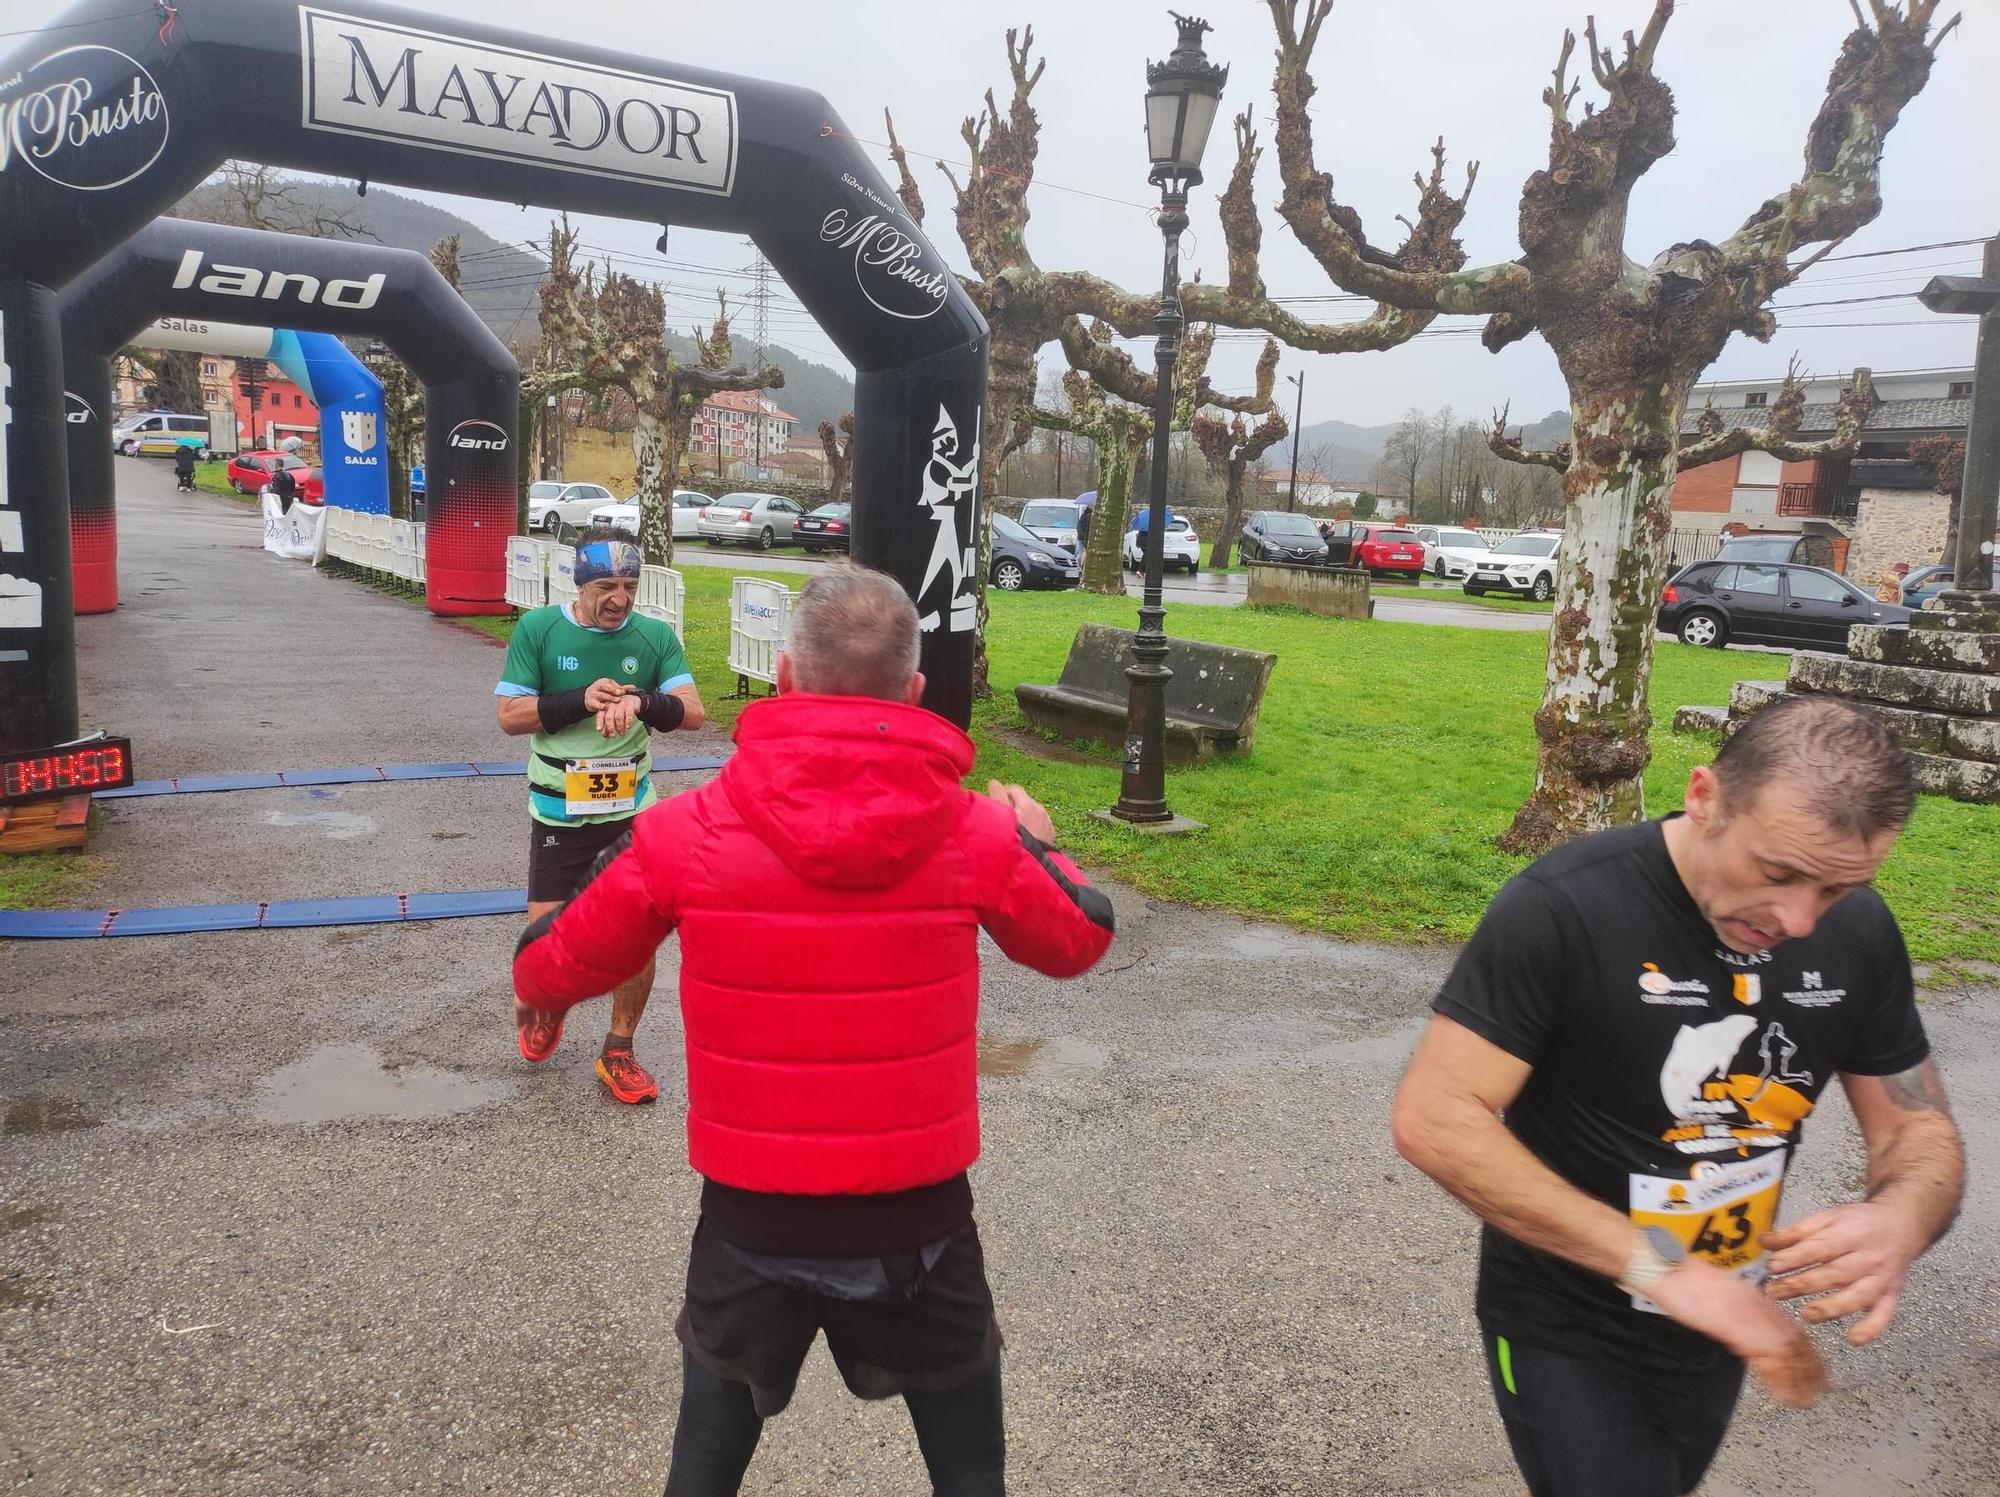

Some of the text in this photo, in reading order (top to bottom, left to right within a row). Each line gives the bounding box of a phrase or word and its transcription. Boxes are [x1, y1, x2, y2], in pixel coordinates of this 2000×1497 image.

[338, 33, 708, 165] MAYADOR
[841, 172, 896, 214] Sidra Natural
[172, 249, 387, 310] land
[160, 318, 208, 335] Salas
[450, 433, 508, 451] land
[344, 456, 378, 466] SALAS
[588, 773, 619, 792] 33
[1690, 1202, 1751, 1254] 43
